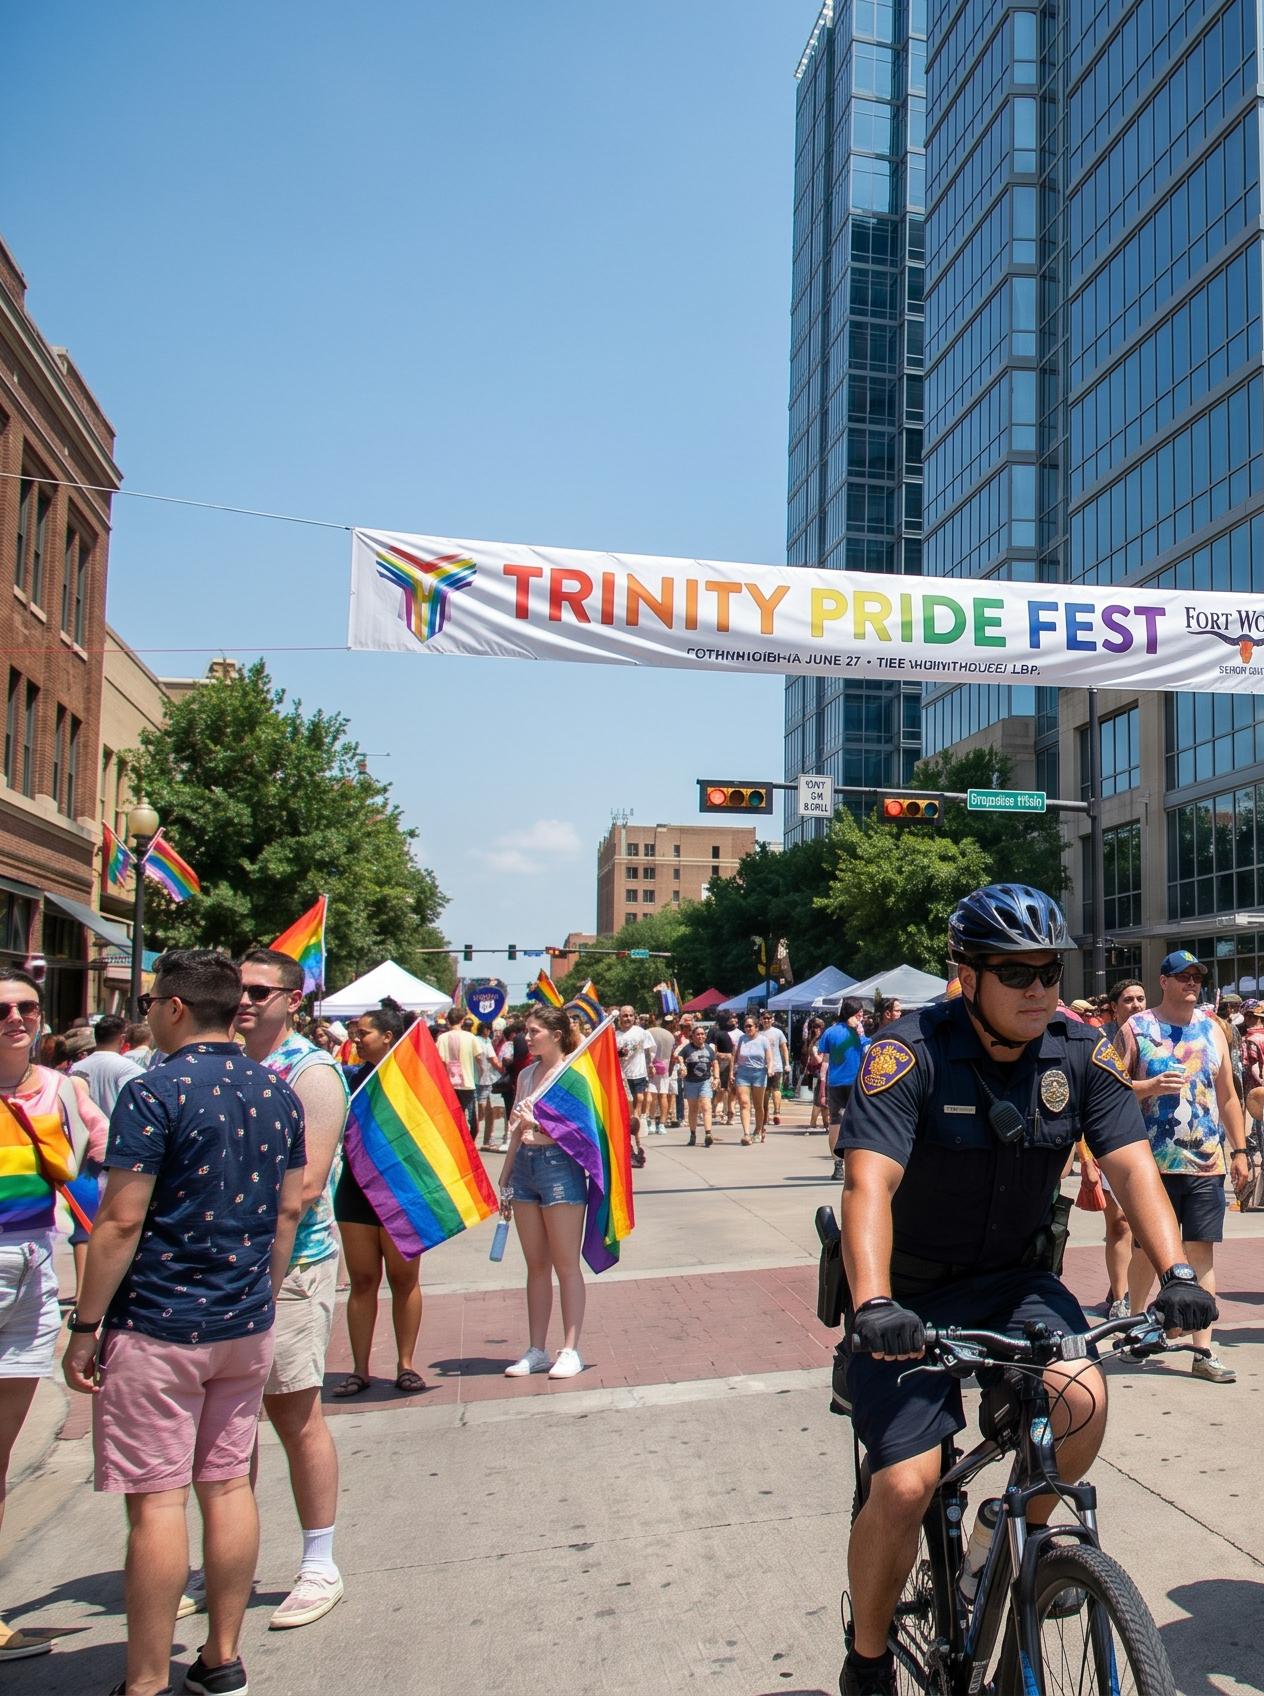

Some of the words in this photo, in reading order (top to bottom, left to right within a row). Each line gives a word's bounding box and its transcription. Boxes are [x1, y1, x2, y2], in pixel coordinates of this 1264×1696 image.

[503, 563, 790, 635] TRINITY
[810, 587, 1007, 648] PRIDE
[1027, 599, 1167, 655] FEST
[1184, 606, 1232, 631] FORT
[805, 654, 842, 666] JUNE
[845, 656, 861, 667] 27
